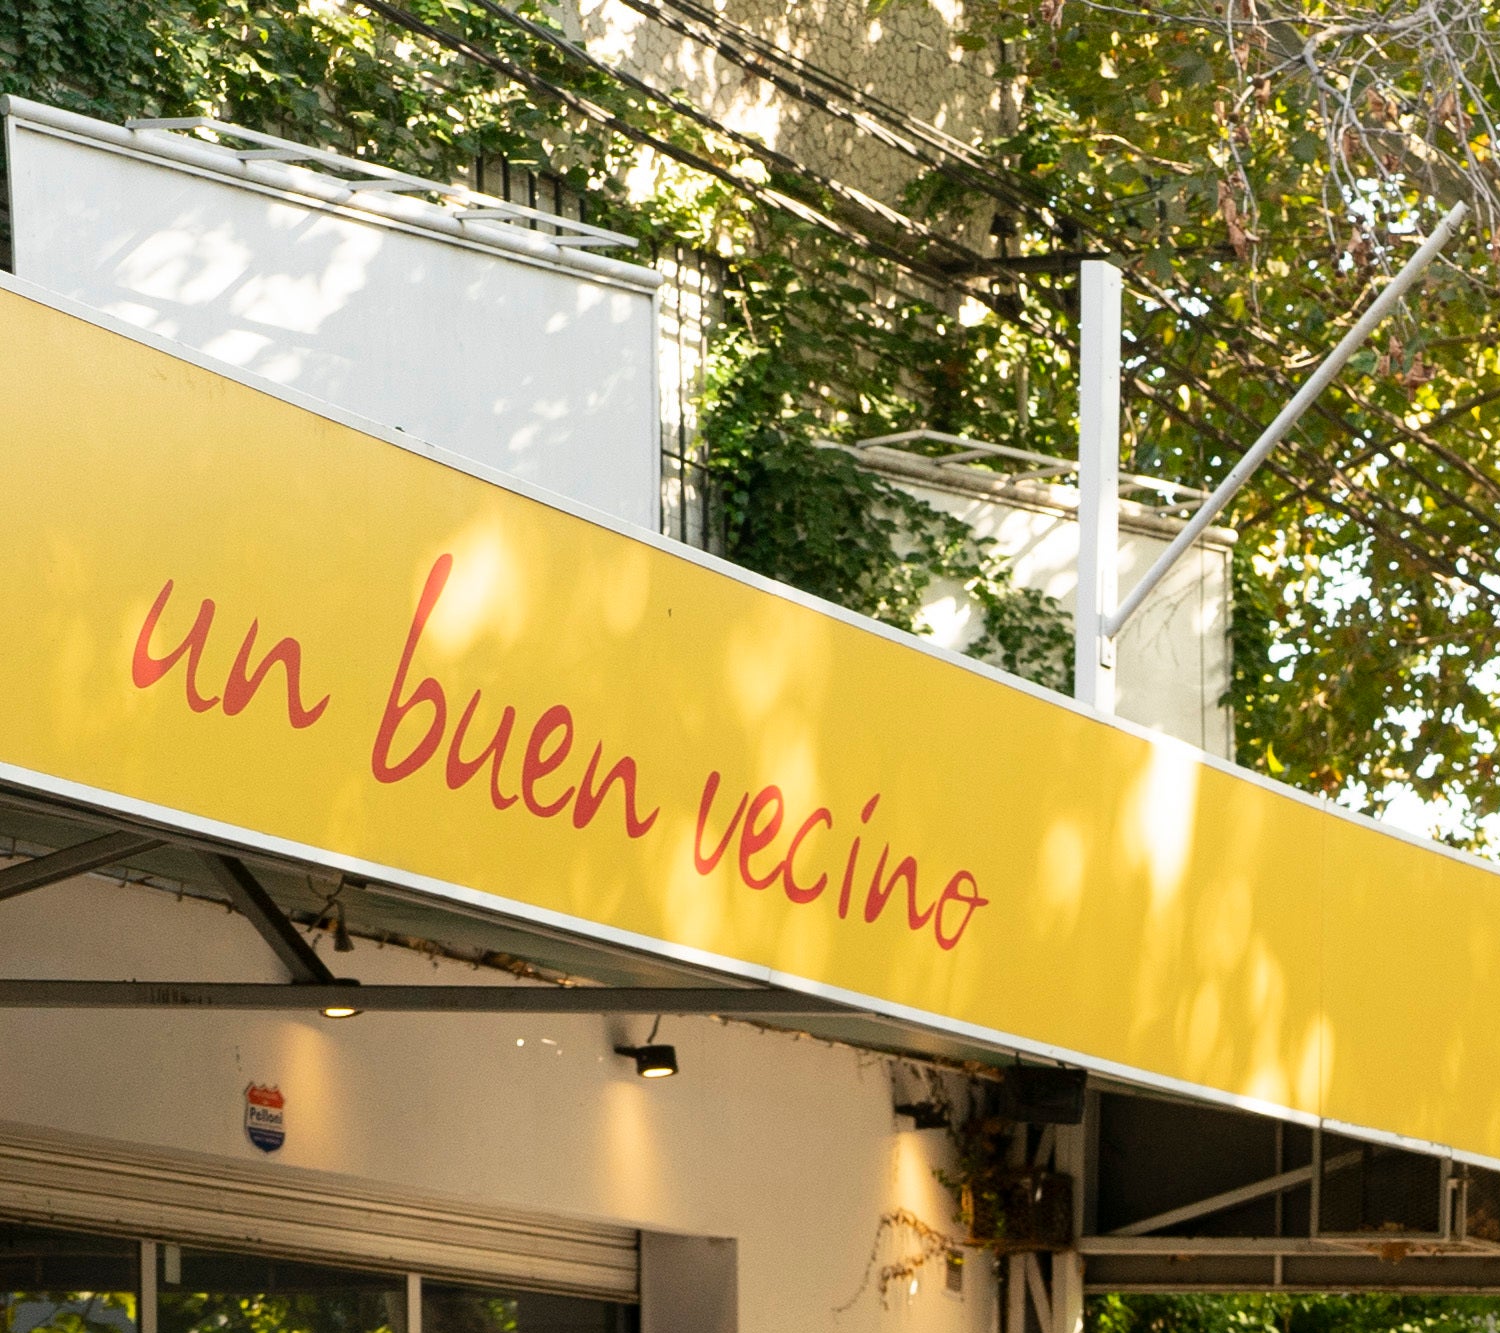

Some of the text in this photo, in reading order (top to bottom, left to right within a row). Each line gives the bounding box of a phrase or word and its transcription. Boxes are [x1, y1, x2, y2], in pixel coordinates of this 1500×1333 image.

[132, 553, 989, 950] un buen vecino
